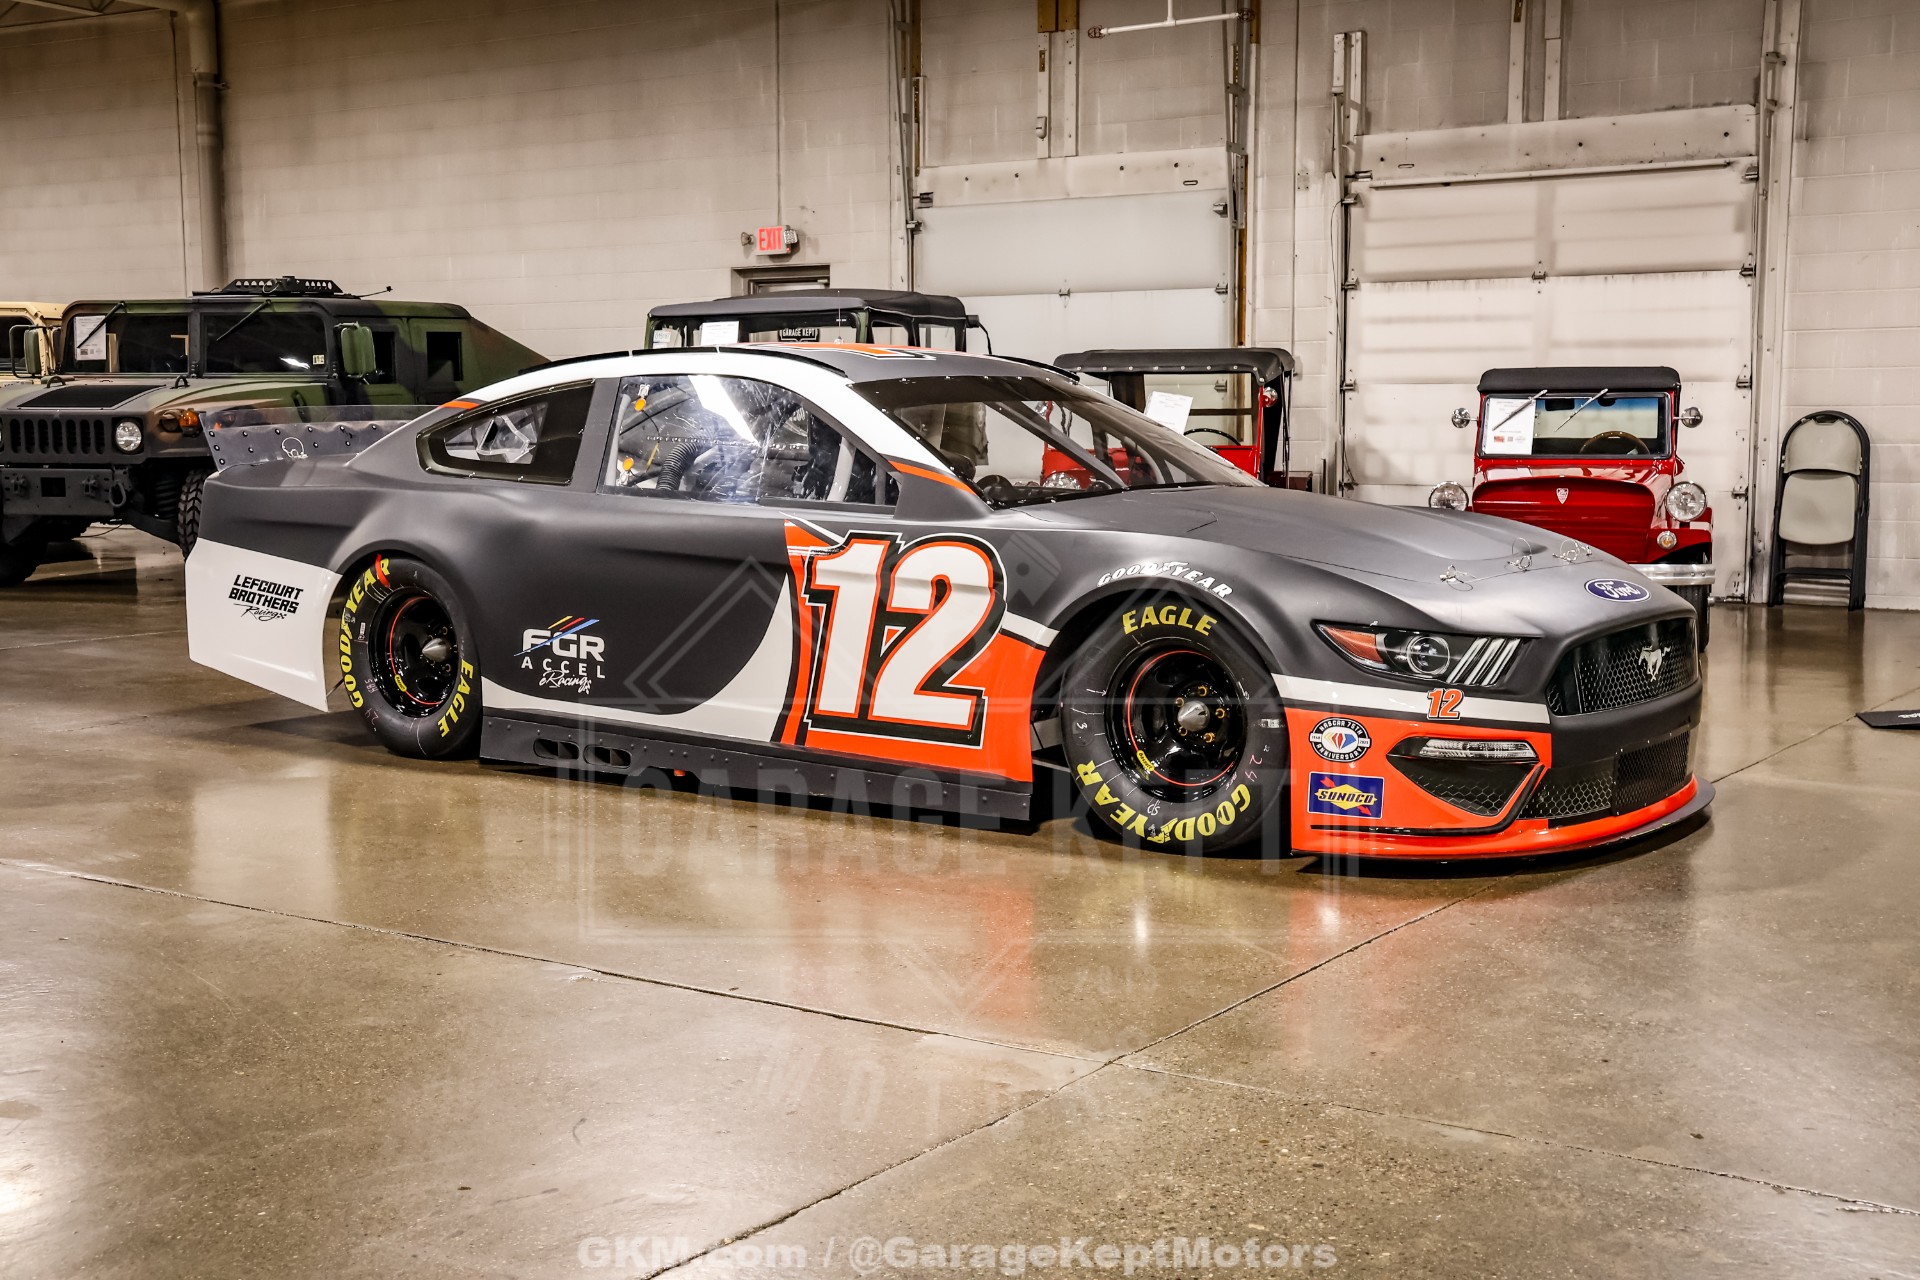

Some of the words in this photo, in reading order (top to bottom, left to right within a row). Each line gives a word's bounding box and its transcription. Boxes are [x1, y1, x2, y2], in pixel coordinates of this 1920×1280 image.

[759, 227, 783, 250] EXIT
[782, 328, 801, 337] GARAGE
[802, 328, 816, 337] KEPT
[233, 574, 304, 600] LEFCOURT
[1097, 561, 1233, 598] GOODYEAR
[1594, 581, 1641, 599] Ford
[228, 587, 300, 614] BROTHERS
[233, 603, 284, 621] Racing
[1122, 605, 1218, 637] EAGLE
[522, 628, 605, 662] FGR
[802, 530, 1007, 749] 12
[521, 656, 606, 679] ACCEL
[437, 658, 474, 738] EAGLE
[1427, 688, 1464, 720] 12
[1318, 720, 1345, 732] NASCAR
[1347, 721, 1364, 736] 75TH
[1315, 743, 1363, 760] ANNIVERSARY
[1076, 760, 1251, 844] GOODYEAR
[1318, 790, 1375, 804] SUNOCO
